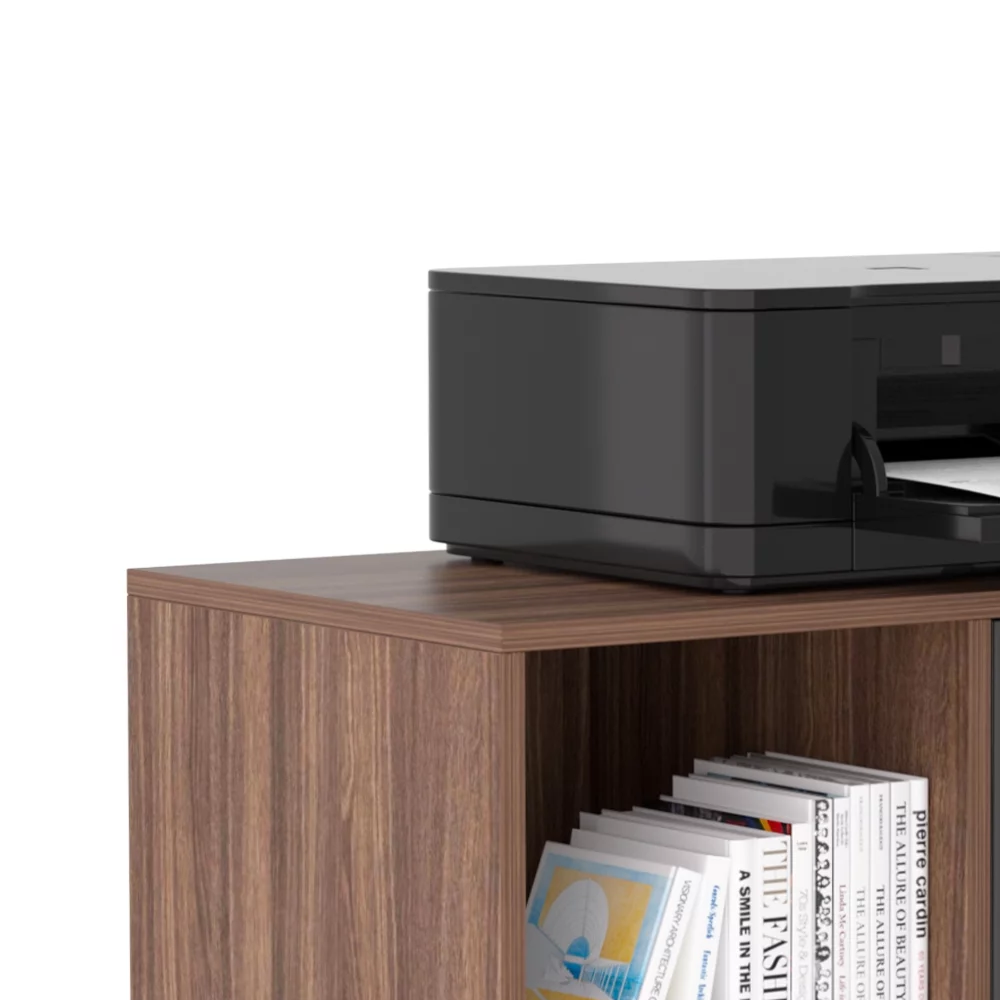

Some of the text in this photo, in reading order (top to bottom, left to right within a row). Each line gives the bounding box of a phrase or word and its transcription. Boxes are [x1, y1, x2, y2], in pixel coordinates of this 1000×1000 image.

[912, 810, 928, 868] pierre
[739, 870, 751, 881] A
[762, 841, 788, 908] THE
[673, 880, 692, 925] VISIONARY
[739, 886, 751, 936] SMILE
[856, 886, 865, 917] THE
[876, 885, 885, 916] THE
[896, 801, 906, 1000] THE ALLURE OF BEAUTY
[915, 876, 928, 938] cardin
[797, 913, 808, 947] Style
[839, 914, 846, 929] Mc
[652, 925, 678, 995] ARCHITECTURE
[739, 941, 751, 958] IN
[837, 930, 846, 967] Cartney
[856, 921, 865, 979] ALLURE
[876, 919, 885, 978] ALLURE
[739, 962, 751, 993] THE
[838, 975, 847, 992] Life
[876, 980, 885, 1000] OF
